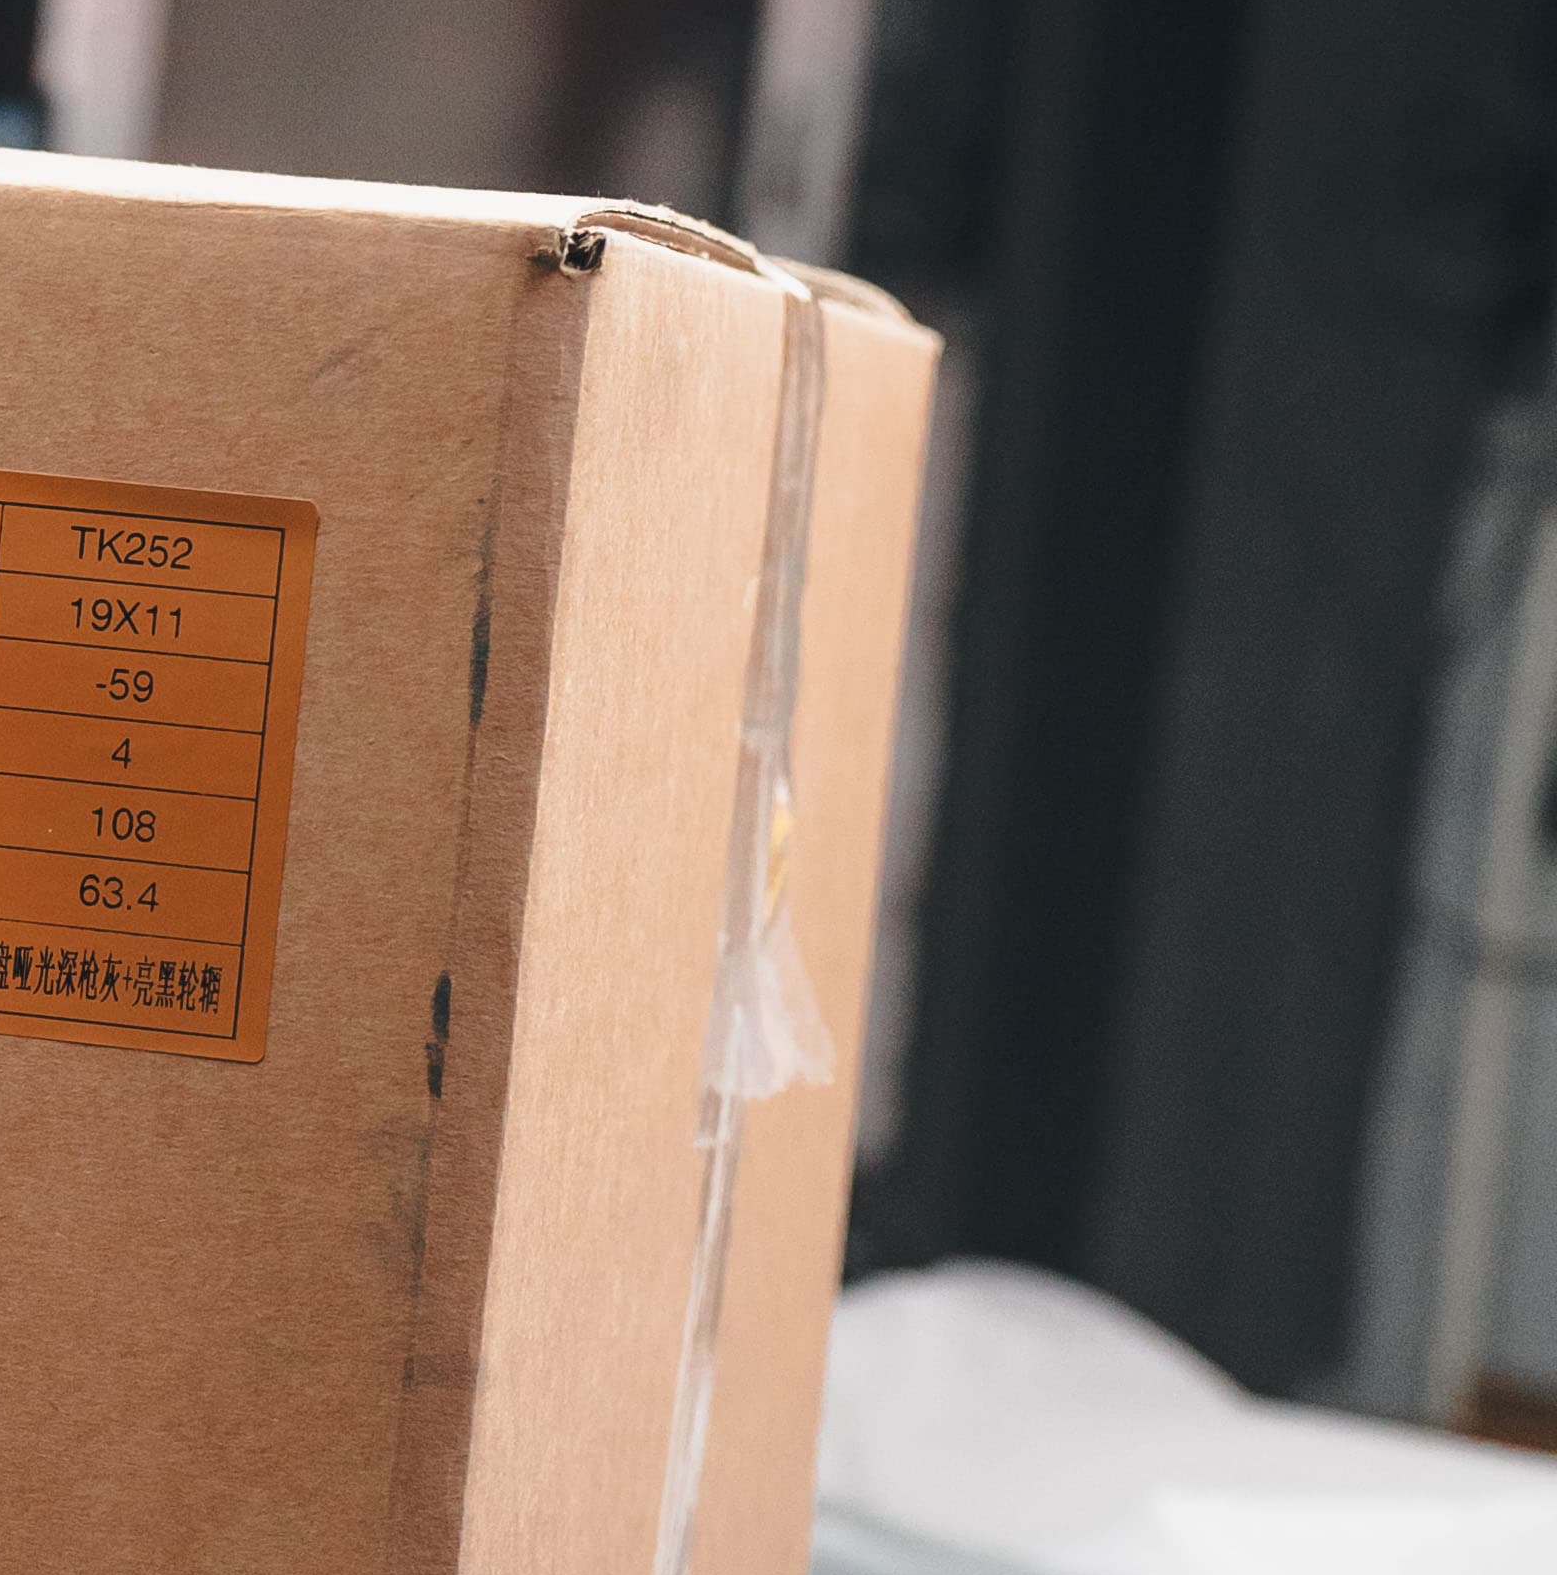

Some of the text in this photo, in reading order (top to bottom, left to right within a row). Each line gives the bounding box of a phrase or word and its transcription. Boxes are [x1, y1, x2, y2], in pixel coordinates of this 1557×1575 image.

[70, 525, 193, 570] TK252
[70, 597, 182, 639] 19X11
[96, 668, 154, 703] -59
[110, 737, 132, 770] 4
[91, 806, 157, 843] 108
[79, 873, 160, 913] 63.4
